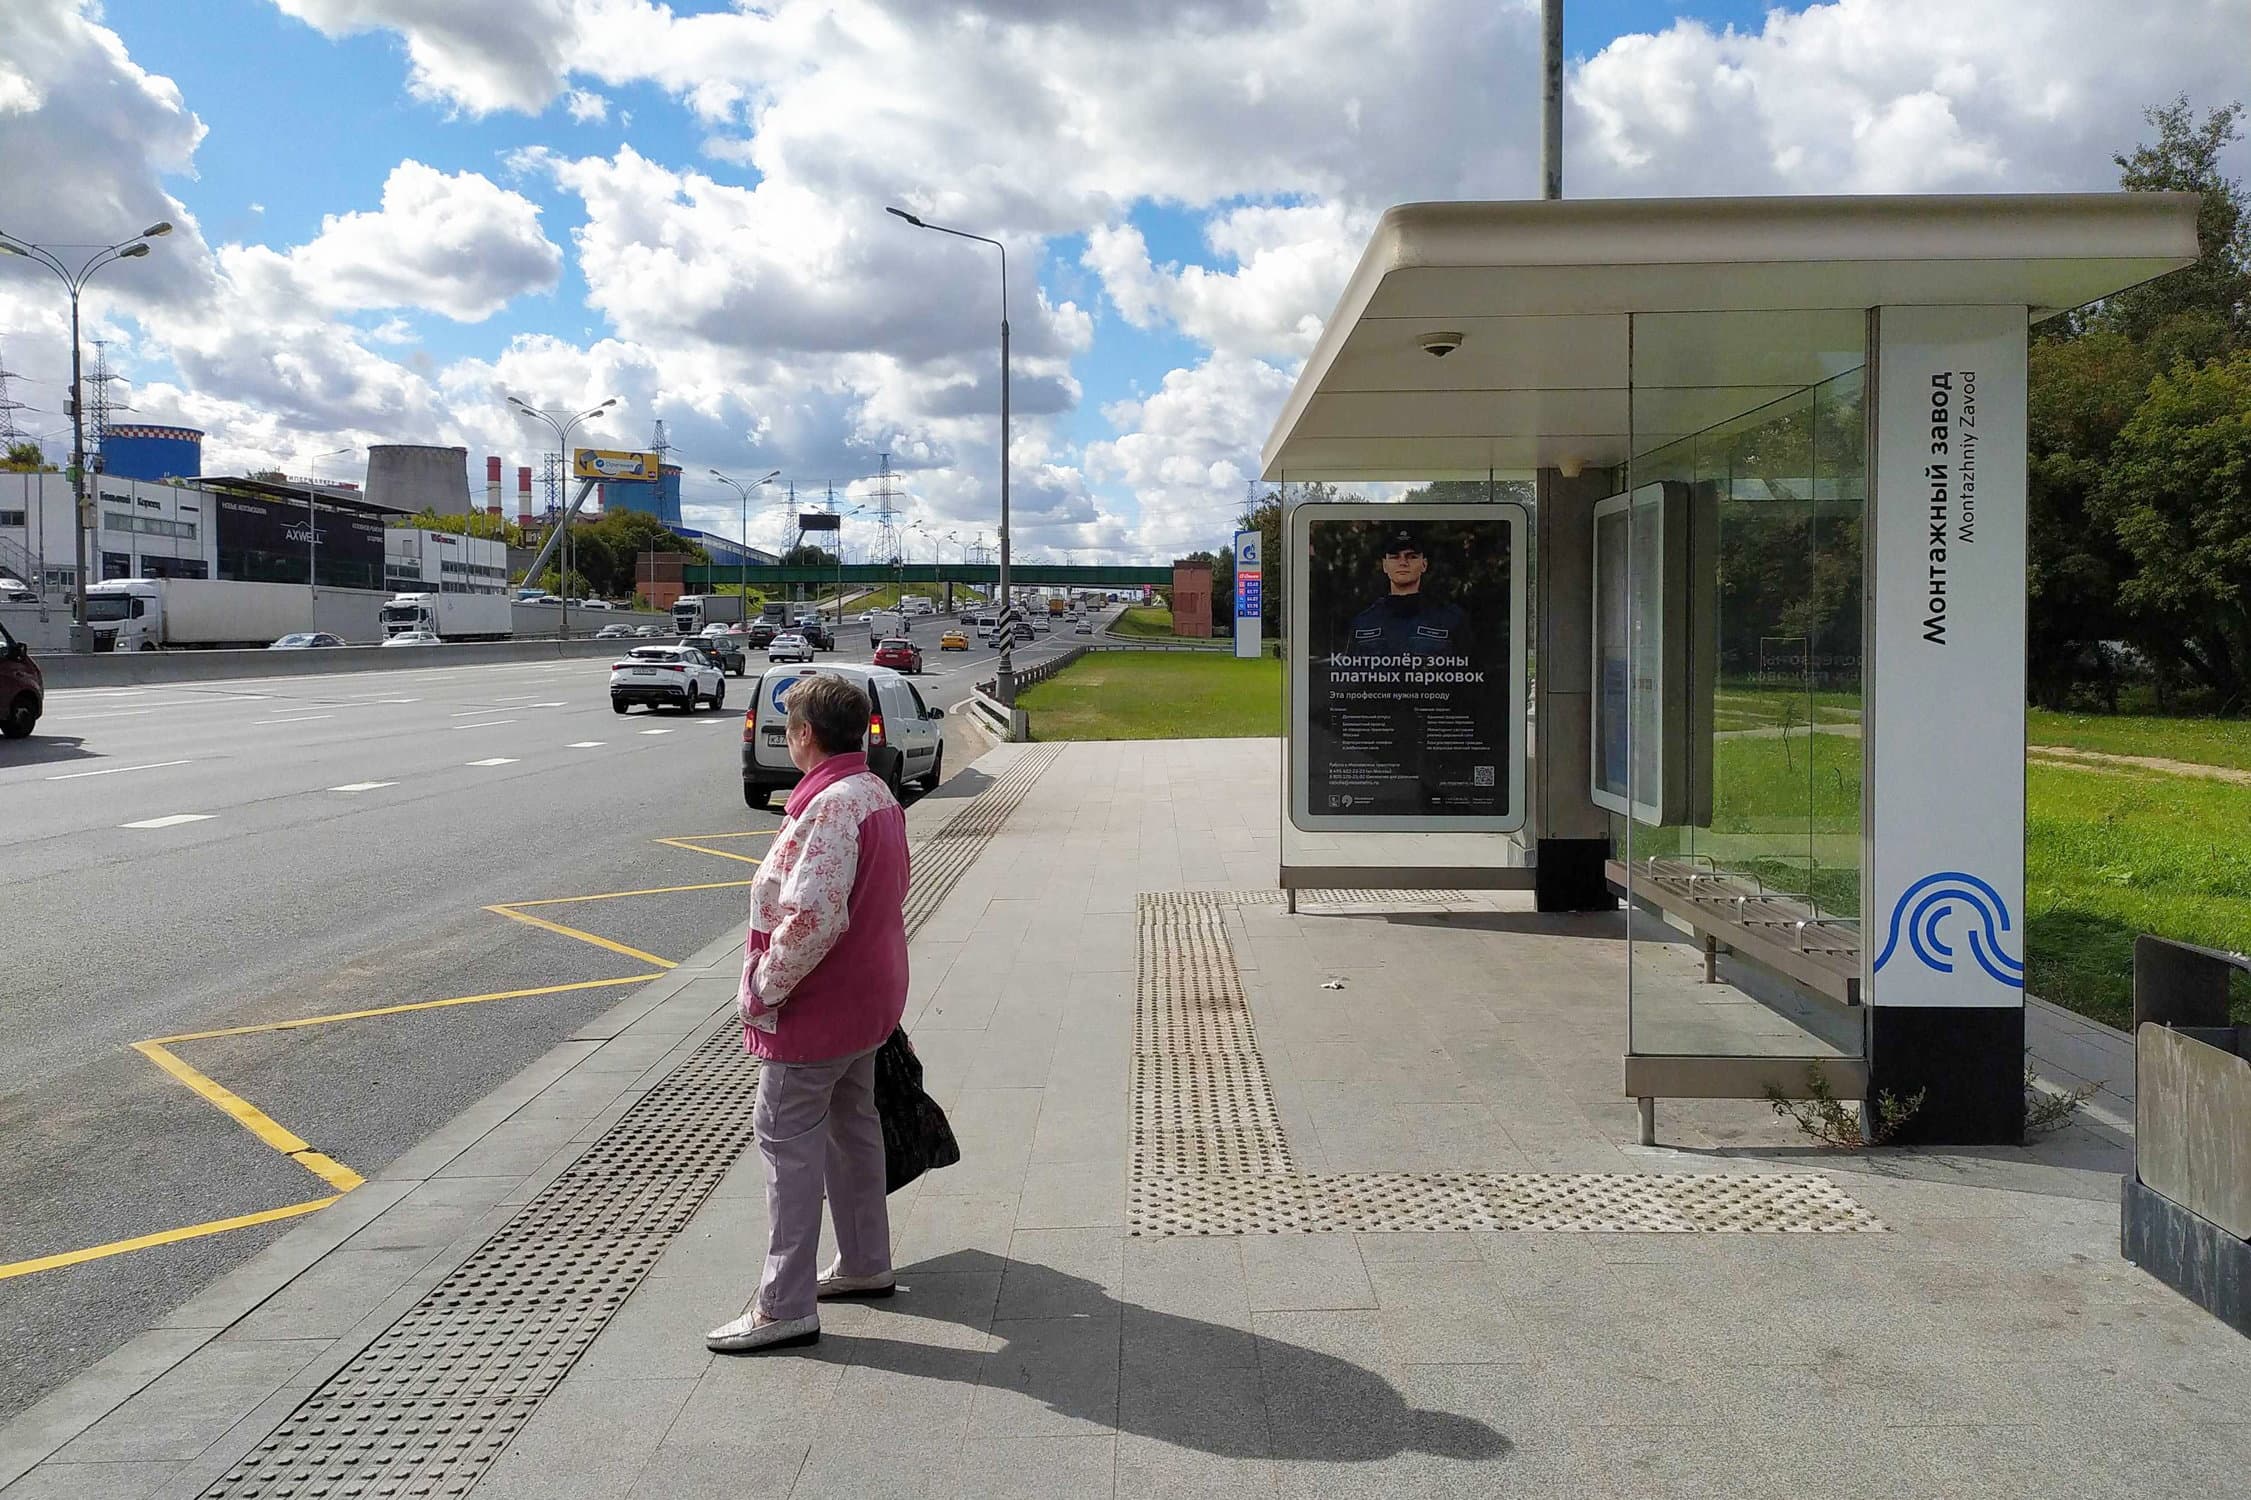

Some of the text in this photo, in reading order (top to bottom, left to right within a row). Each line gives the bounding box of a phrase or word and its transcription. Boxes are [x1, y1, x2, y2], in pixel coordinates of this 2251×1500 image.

[1958, 371, 1979, 543] Montazhniy Zavod
[1923, 371, 1952, 645] Монтажный завод
[1330, 652, 1469, 669] Контролёр зоны
[1330, 671, 1485, 686] платных парковок
[1329, 690, 1450, 700] Эта профессия нужна городу
[770, 735, 786, 744] К37
